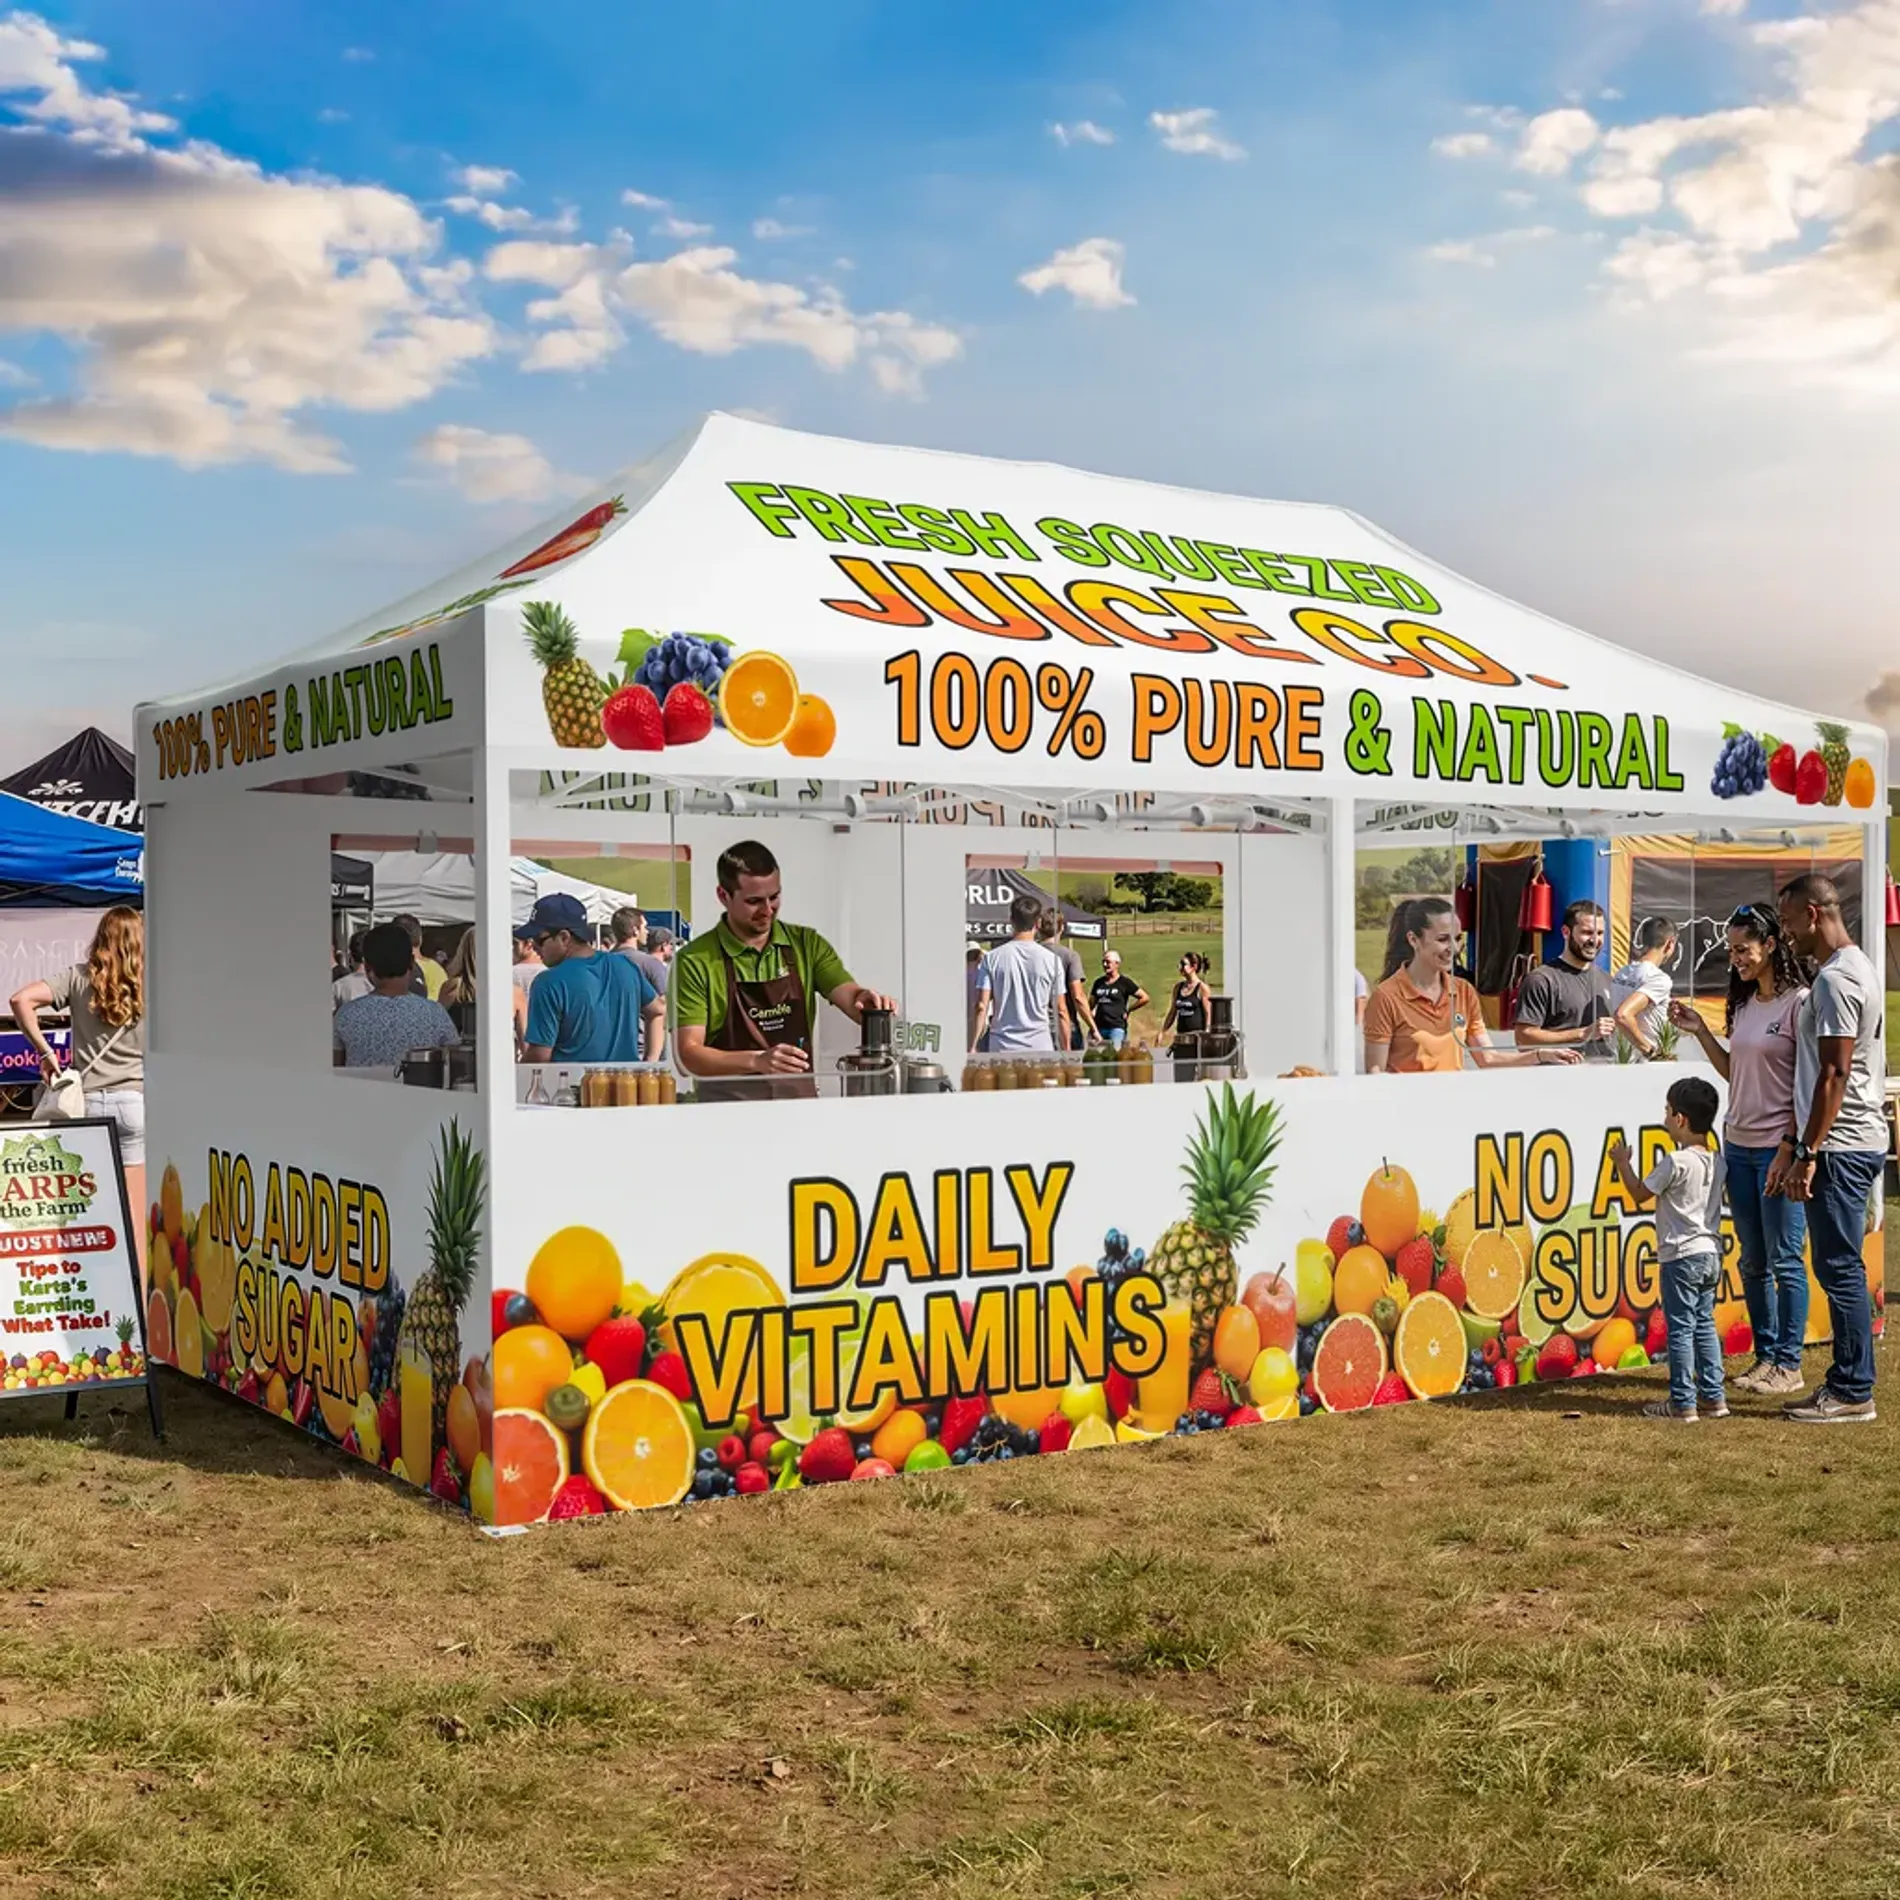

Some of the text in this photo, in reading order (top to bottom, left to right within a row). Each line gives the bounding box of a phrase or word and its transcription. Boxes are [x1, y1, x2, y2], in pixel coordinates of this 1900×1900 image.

[725, 481, 1442, 616] FRESH SQUEEZED
[820, 555, 1570, 690] JUICE CO.
[152, 643, 453, 780] 100% PURE & NATURAL
[885, 650, 1685, 792] 100% PURE & NATURAL
[965, 885, 1015, 905] RLD
[36, 1201, 87, 1217] Farm
[209, 1147, 391, 1294] NO ADDED
[788, 1161, 1075, 1294] DAILY
[1475, 1129, 1574, 1229] NO
[2, 1310, 111, 1334] What Take!
[60, 1260, 81, 1274] to
[235, 1257, 358, 1408] SUGAR
[1534, 1214, 1746, 1325] SUGR
[673, 1273, 1167, 1430] VITAMINS
